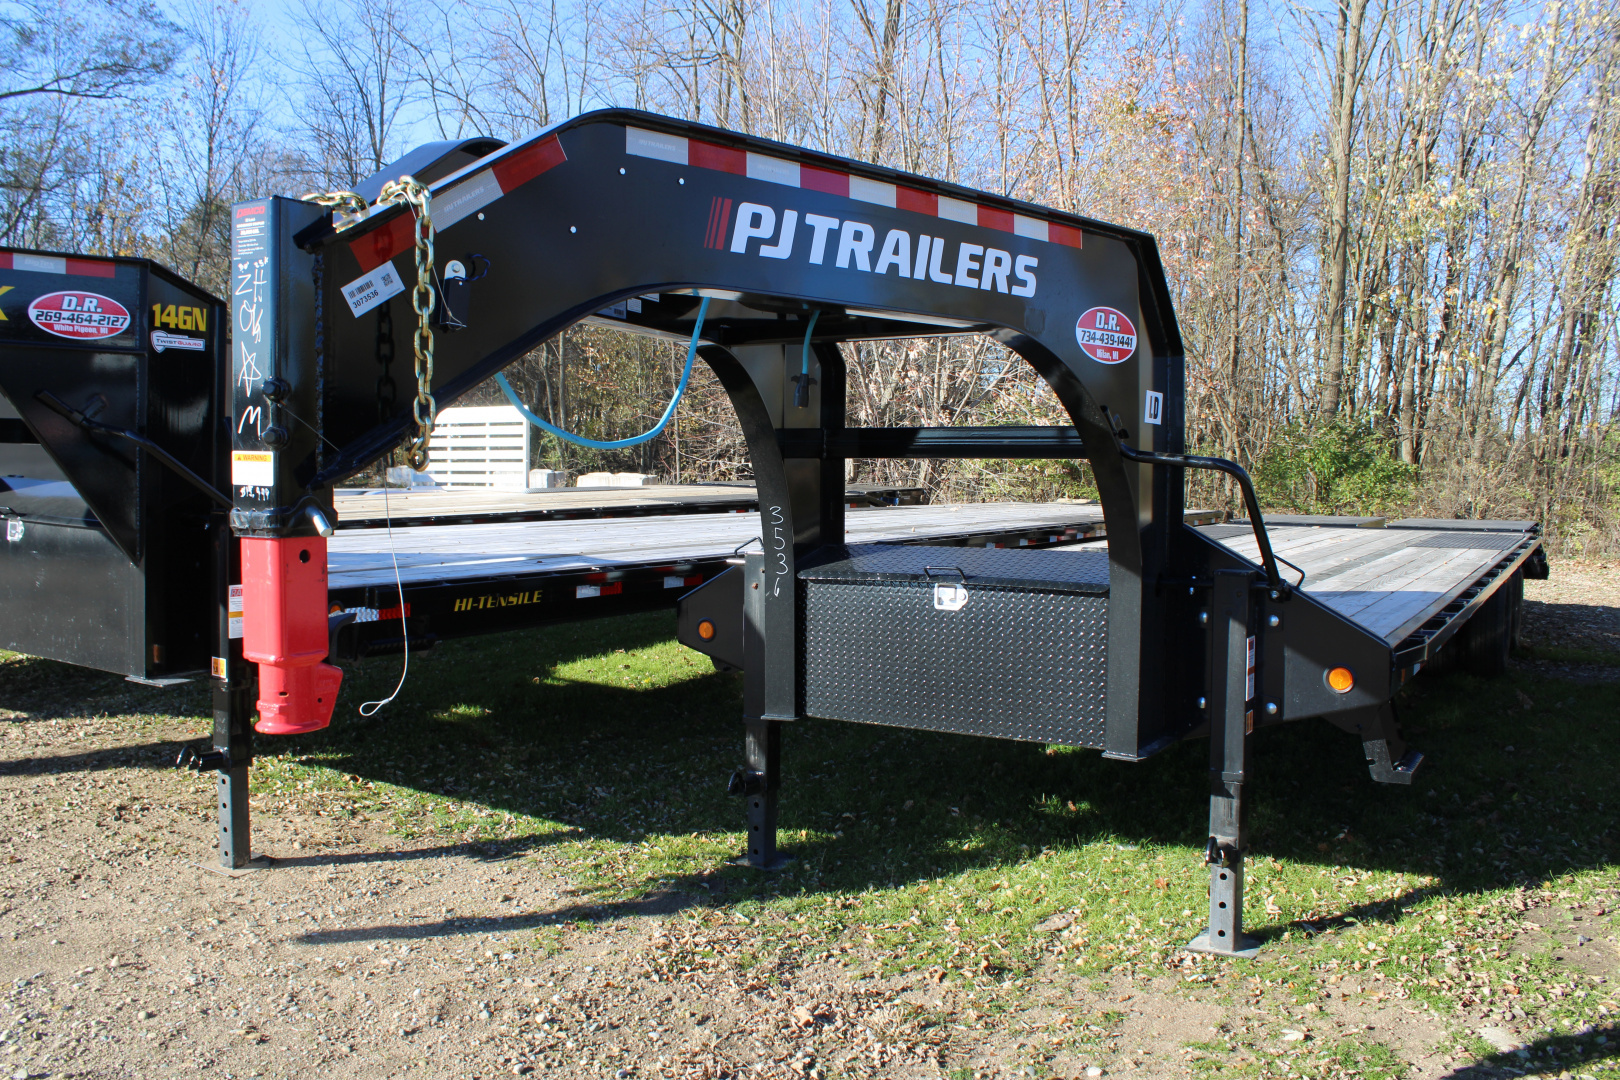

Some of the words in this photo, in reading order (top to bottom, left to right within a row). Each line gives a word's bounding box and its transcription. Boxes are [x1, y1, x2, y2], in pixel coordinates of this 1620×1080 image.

[804, 212, 1039, 298] TRAILERS
[61, 295, 103, 313] D.R.
[352, 289, 379, 309] 3073536
[35, 310, 128, 327] 269-464-2127
[152, 303, 207, 332] 14GN
[1095, 311, 1121, 332] D.R.
[53, 323, 73, 332] White
[1080, 329, 1133, 348] 734-439-1441
[1096, 348, 1112, 361] Milan,
[1112, 350, 1119, 360] MI
[243, 454, 268, 462] WARNING
[453, 589, 544, 612] HI-TENSILE
